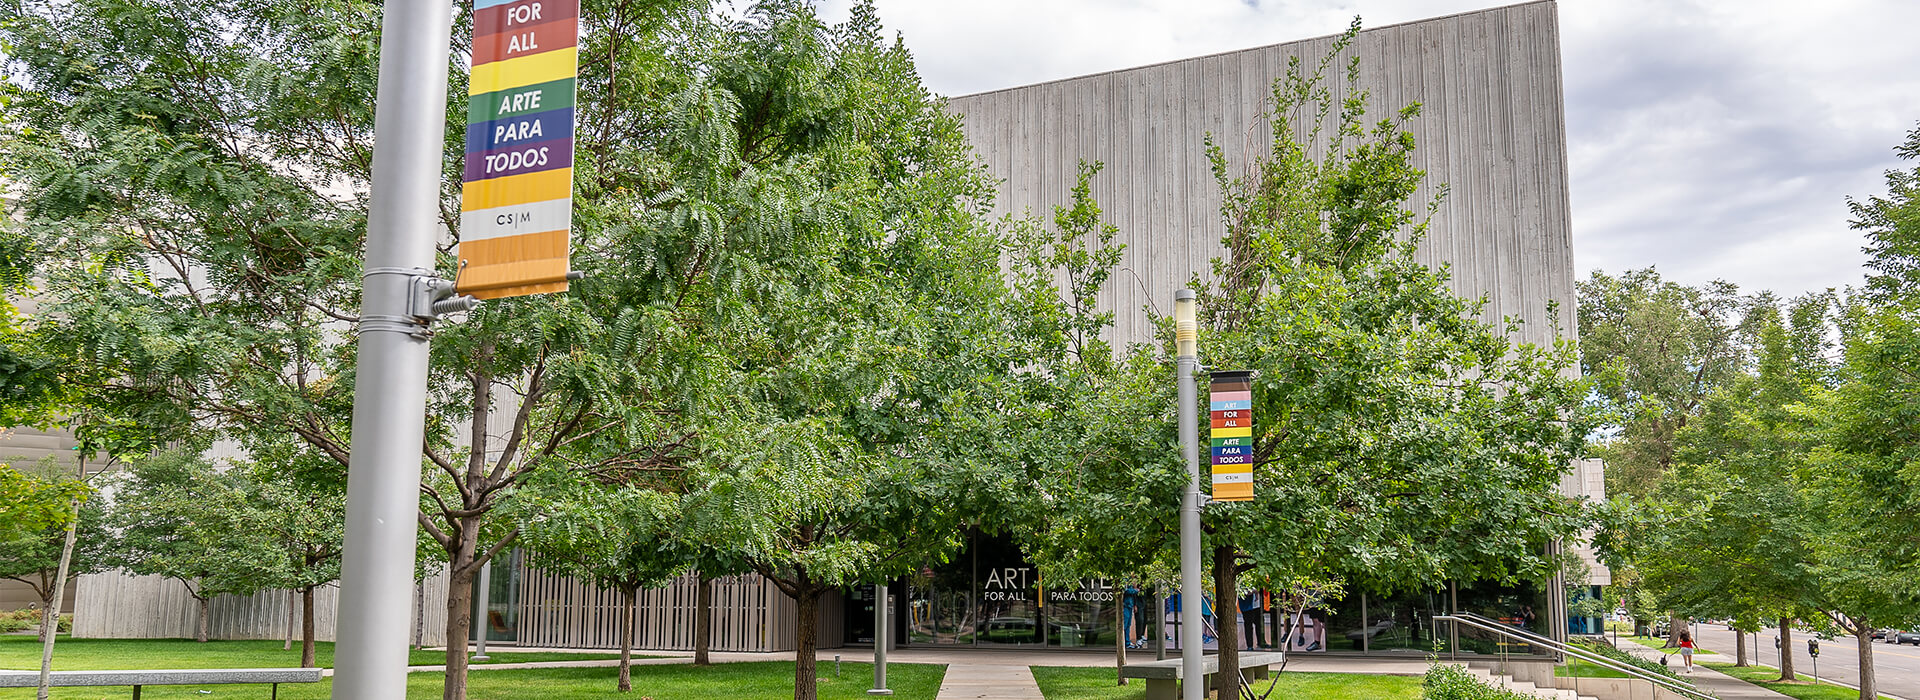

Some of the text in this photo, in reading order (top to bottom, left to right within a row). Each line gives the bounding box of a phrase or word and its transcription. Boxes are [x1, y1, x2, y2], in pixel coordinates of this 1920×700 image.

[507, 2, 542, 26] FOR
[507, 32, 538, 54] ALL
[498, 90, 542, 115] ARTE
[494, 119, 543, 144] PARA
[485, 147, 549, 174] TODOS
[1221, 447, 1241, 455] PARA
[1222, 438, 1240, 446] ARTE
[1219, 456, 1244, 464] TODOS
[985, 567, 1030, 590] ART
[984, 591, 1026, 601] FOR ALL
[1051, 591, 1114, 601] PARA TODOS
